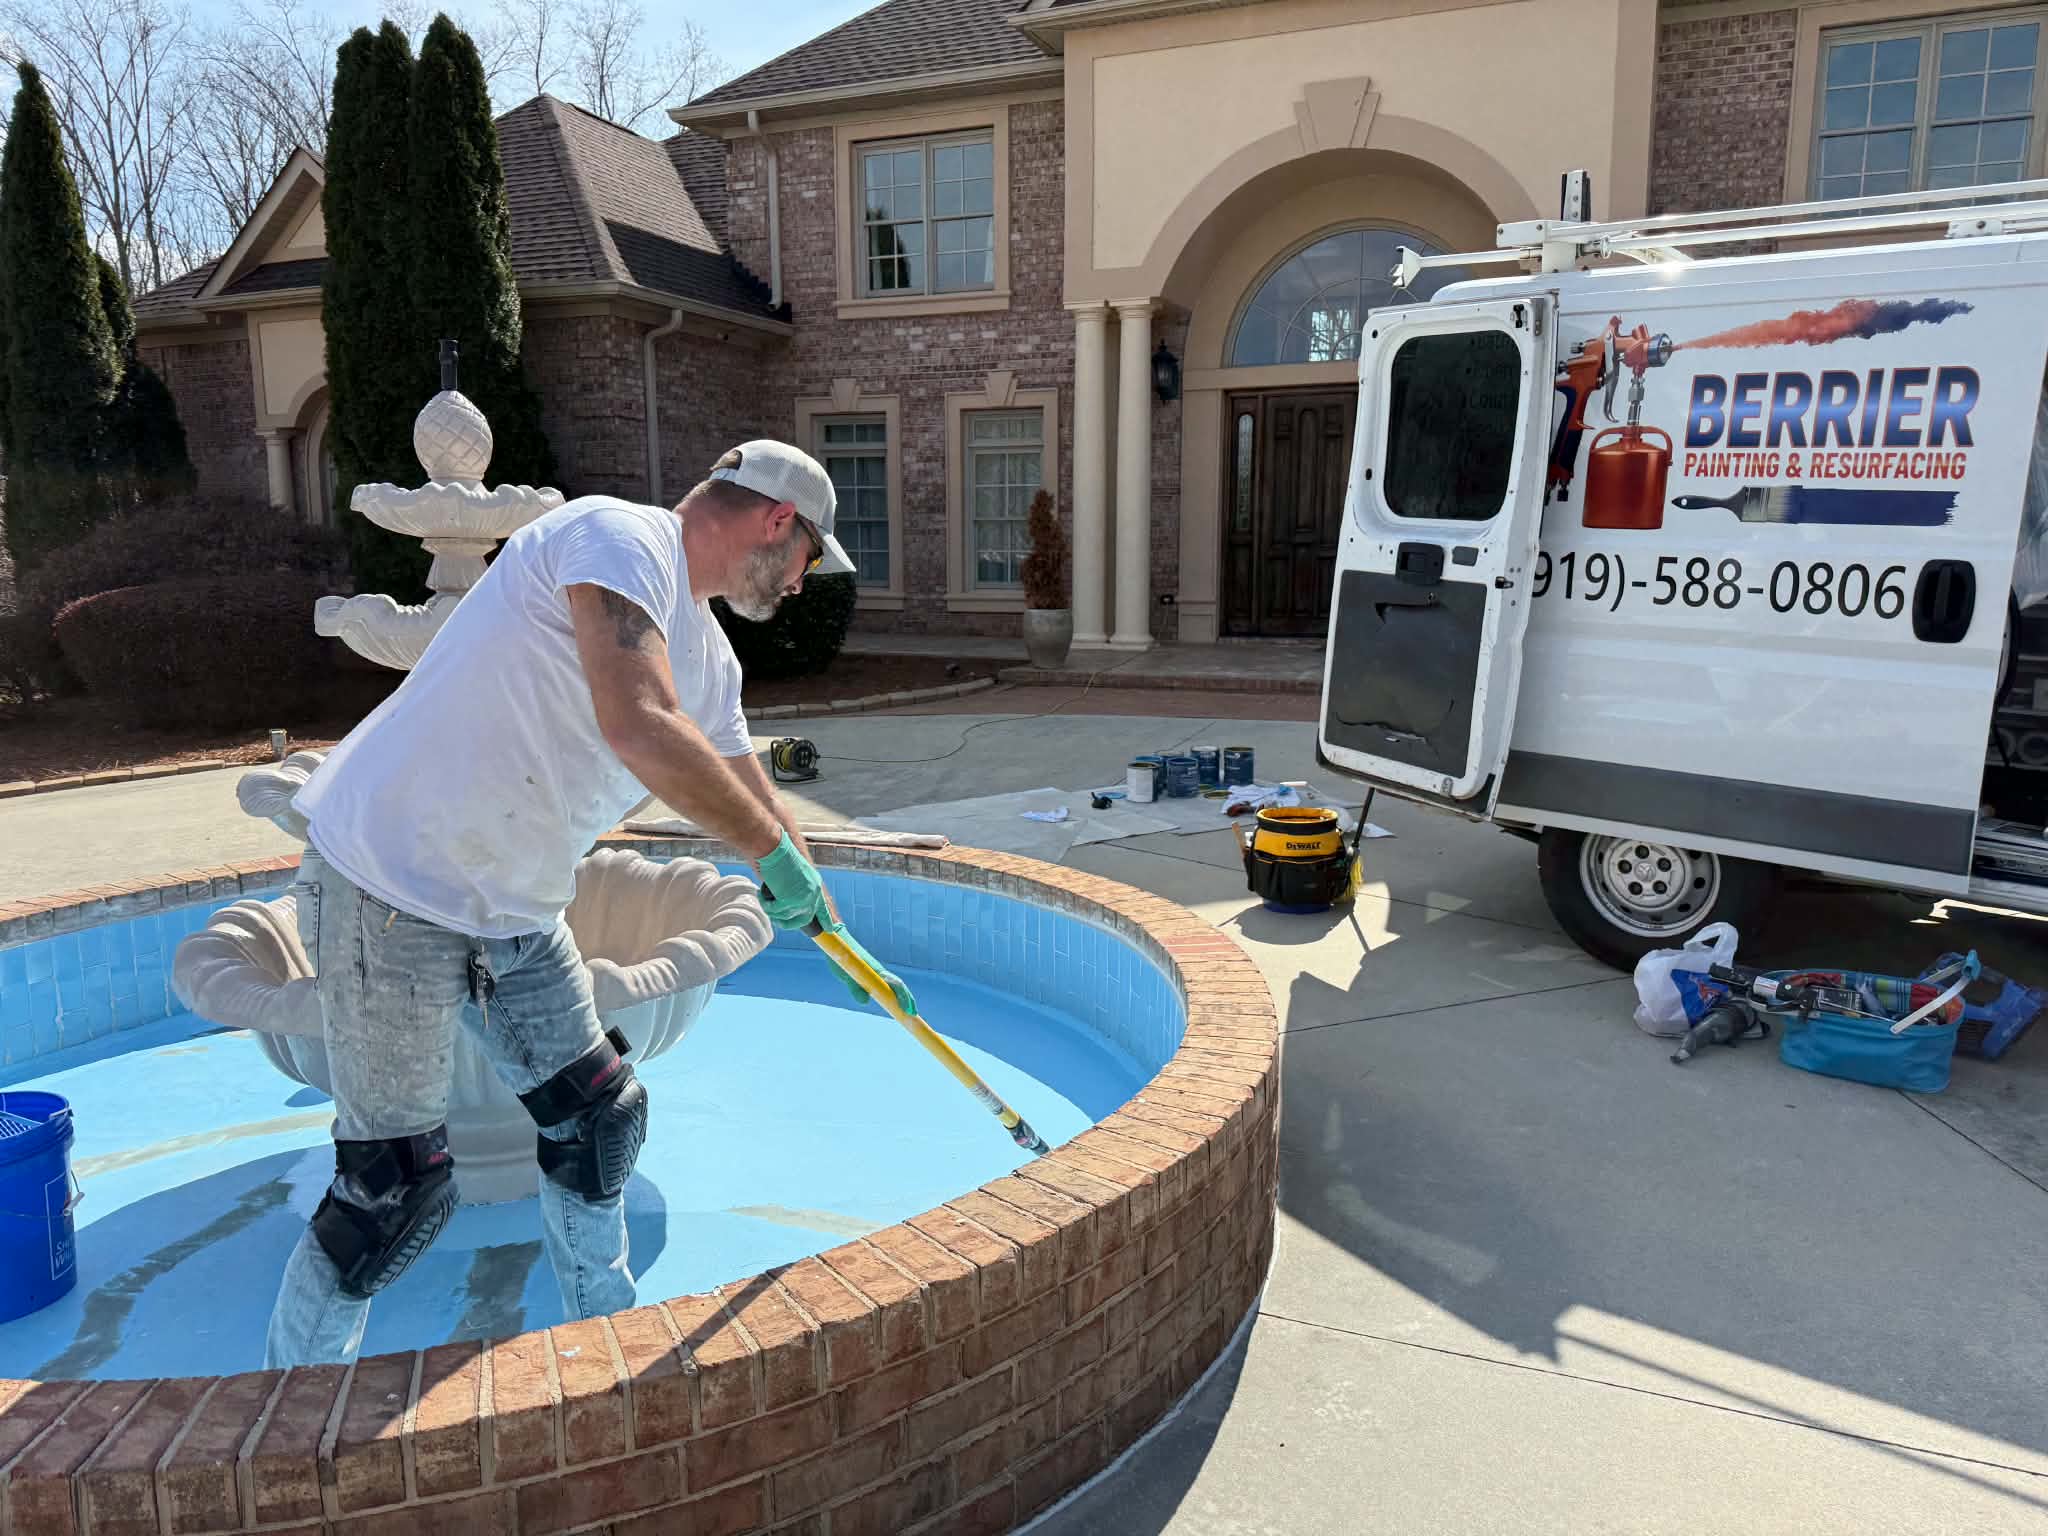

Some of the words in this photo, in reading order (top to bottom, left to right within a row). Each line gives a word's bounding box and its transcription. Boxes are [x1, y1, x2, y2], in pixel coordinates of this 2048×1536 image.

[1684, 365, 1980, 449] BERRIER
[1684, 452, 1780, 478] PAINTING
[1785, 453, 1802, 478] &
[1810, 452, 1967, 480] RESURFACING
